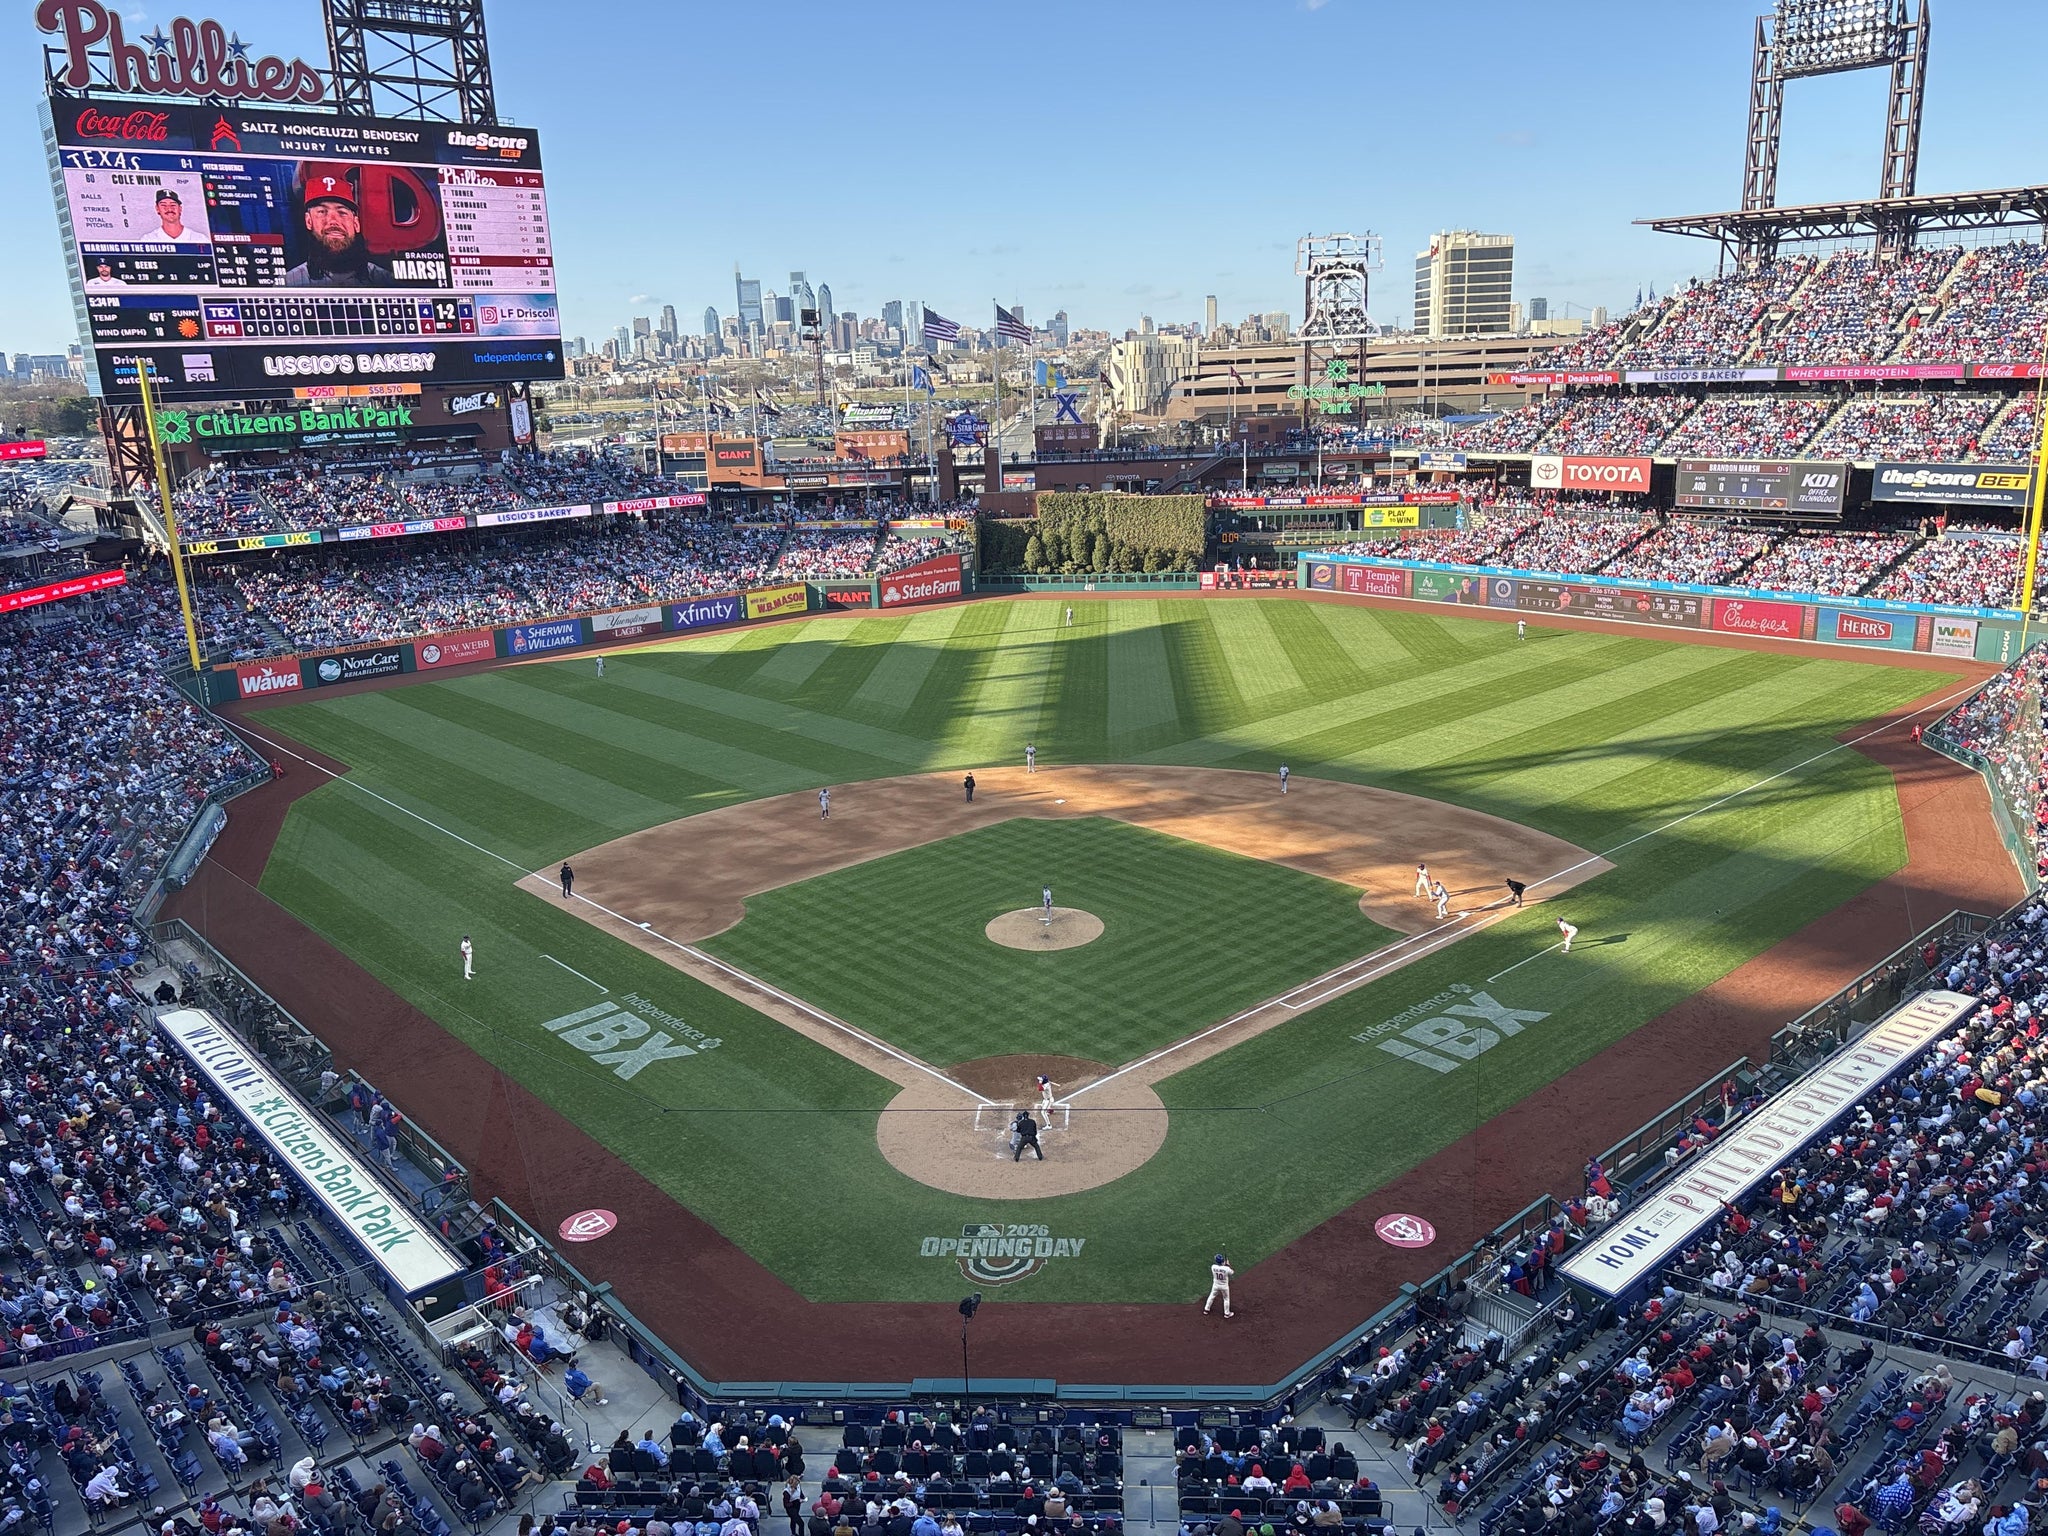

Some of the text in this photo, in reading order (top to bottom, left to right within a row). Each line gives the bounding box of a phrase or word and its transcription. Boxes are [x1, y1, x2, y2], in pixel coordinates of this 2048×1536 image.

[34, 0, 326, 104] Phillies
[76, 107, 170, 142] Coca-Cola
[241, 122, 420, 143] SALTZ MONGELUZZI BENDESKY
[447, 132, 528, 149] theScore
[280, 140, 390, 155] INJURY LAWYERS
[67, 150, 141, 170] TEXAS
[181, 158, 193, 169] 0-1
[112, 174, 161, 186] COLE WINN
[438, 167, 498, 186] Phillies
[84, 243, 176, 253] WARMING IN THE BULLPEN
[135, 260, 158, 270] BEEKS
[393, 261, 447, 280] MARSH
[89, 297, 120, 307] 5:34 PM
[93, 314, 118, 322] TEMP
[209, 307, 235, 318] TEX
[436, 303, 456, 320] 1-2
[500, 307, 555, 318] LF Driscoll
[95, 329, 147, 337] WIND (MPH)
[214, 324, 236, 334] PHI
[264, 352, 436, 376] LISCIO'S BAKERY
[474, 352, 542, 364] Independence
[1654, 370, 1746, 381] LISCIO'S BAKERY
[1791, 368, 1909, 378] WHEY BETTER PROTEIN
[1979, 365, 2016, 377] Coca-Cola
[116, 374, 174, 386] outcmes.
[1510, 375, 1536, 383] Phillies
[1568, 374, 1588, 382] Deals
[1288, 381, 1385, 400] Citizens Bank
[452, 392, 487, 415] GHOST
[1320, 400, 1352, 414] Park
[196, 404, 413, 436] Citizens Bank Park
[718, 450, 751, 459] GIANT
[1567, 464, 1643, 484] TOYOTA
[1709, 463, 1760, 472] BRANDON MARSH
[1881, 470, 2023, 488] theScore BET
[1692, 481, 1706, 491] .400
[1799, 494, 1838, 503] TECHNOLOGY
[1895, 490, 1919, 498] Gambling
[620, 494, 704, 510] TOYOTA TOYOTA
[497, 507, 572, 522] LISCIO'S BAKERY
[1388, 509, 1407, 517] PLAY
[374, 519, 464, 536] NECA NECA
[190, 532, 310, 553] UKG UKG UKG
[1222, 532, 1239, 543] 0:09
[1365, 569, 1401, 582] Temple
[1366, 583, 1398, 595] Health
[826, 591, 871, 603] GIANT
[677, 601, 733, 625] xfinity
[1934, 606, 1972, 615] Independence
[1993, 611, 2016, 619] ibx.com
[489, 621, 526, 631] ASPLUNDH
[534, 615, 570, 624] ASPLUNDH
[606, 612, 649, 628] Yuengling
[1723, 608, 1789, 633] Chick-fil-A
[442, 628, 481, 638] ASPLUNDH
[528, 623, 573, 639] SHERWIN
[614, 625, 643, 637] LAGER
[1842, 619, 1887, 637] HERR'S
[1938, 626, 1972, 638] WM
[394, 633, 435, 645] ASPLUNDH
[462, 640, 490, 651] WEBB
[344, 641, 387, 653] ASPLUNDH
[2000, 630, 2011, 662] 330
[291, 648, 336, 660] ASPLUNDH
[454, 650, 480, 658] COMPANY
[237, 656, 283, 668] ASPLUNDH
[343, 653, 399, 670] NovaCare
[344, 664, 399, 679] REHABILITATION
[203, 677, 211, 706] 329
[621, 992, 716, 1040] Independence
[1349, 991, 1456, 1044] Independence
[1375, 990, 1552, 1074] IBX
[1854, 996, 1960, 1070] PHILLIES
[540, 1001, 698, 1081] IBX
[182, 1025, 266, 1092] WELCOME
[1668, 1067, 1870, 1214] PHILADELPHIA
[263, 1109, 416, 1254] Citizens Bank Park
[1006, 1223, 1050, 1236] 2026
[920, 1236, 1087, 1257] OPENING DAY
[1595, 1224, 1661, 1270] HOME
